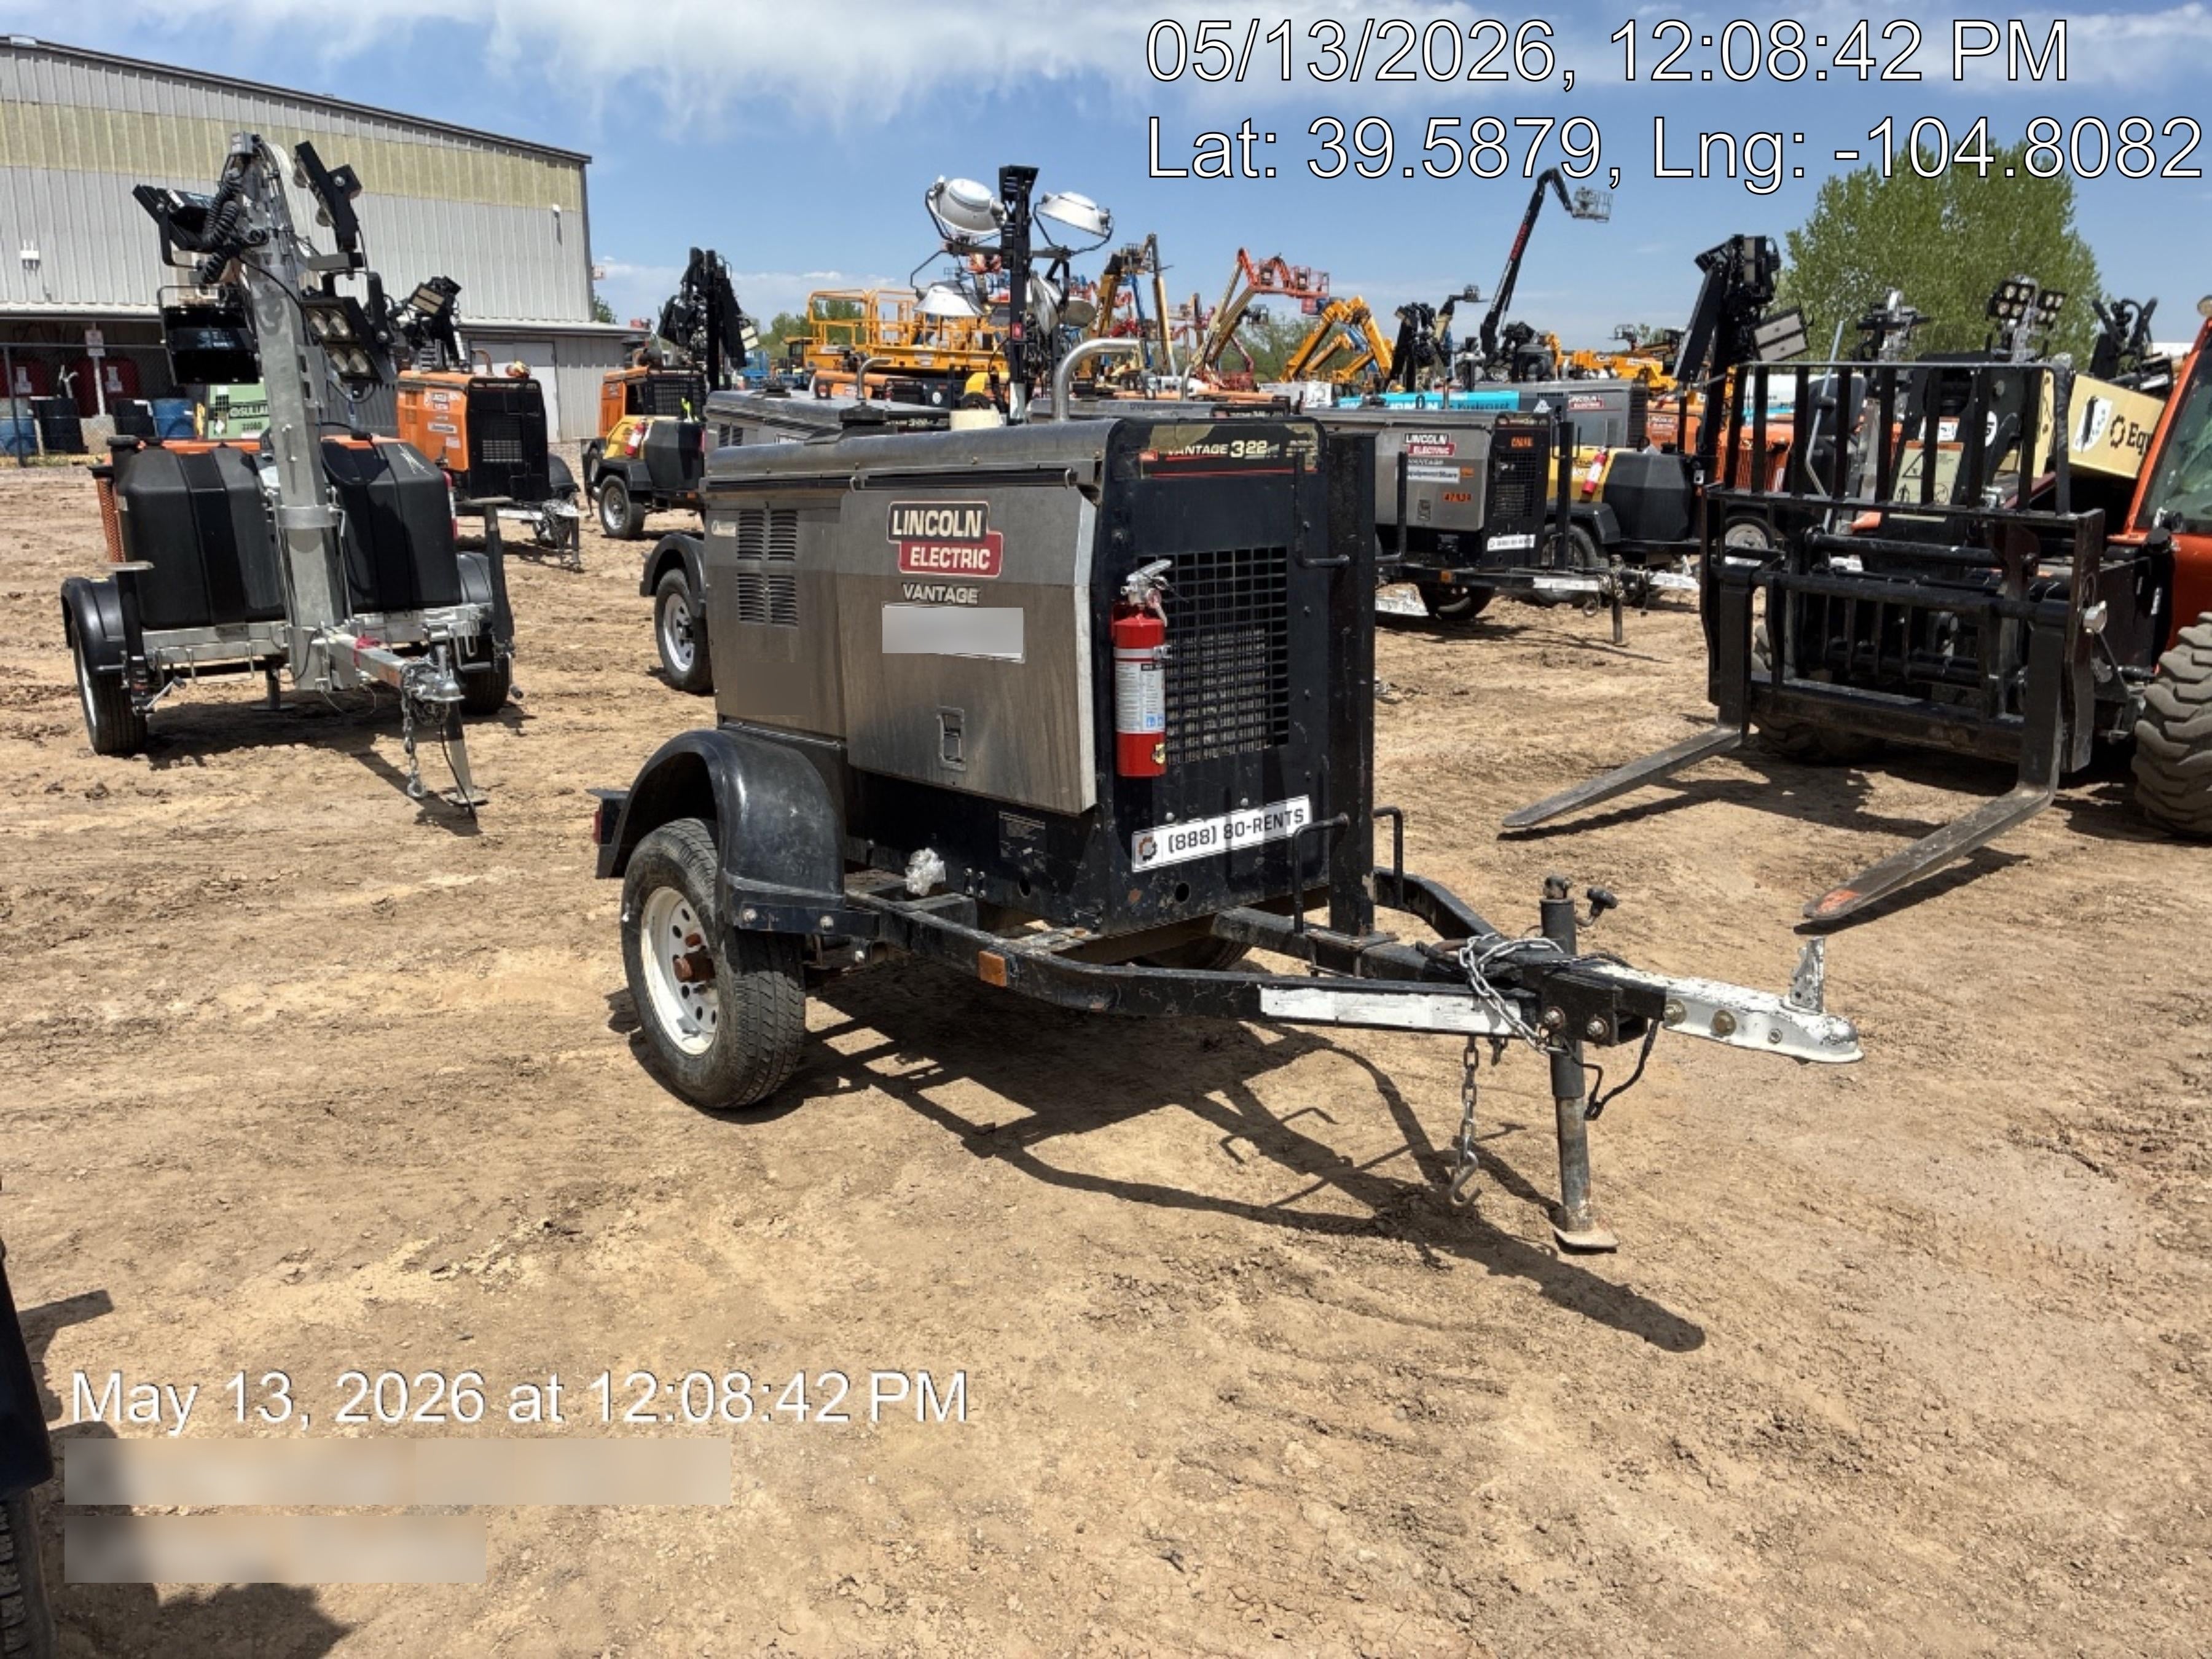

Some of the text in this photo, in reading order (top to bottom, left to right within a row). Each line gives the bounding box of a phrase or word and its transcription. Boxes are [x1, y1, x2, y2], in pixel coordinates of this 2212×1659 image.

[1231, 440, 1268, 458] 322
[892, 509, 982, 538] LINCOLN
[910, 546, 990, 570] ELECTRIC
[902, 583, 979, 604] VANTAGE
[1169, 808, 1304, 853] (888) 80-RENTS
